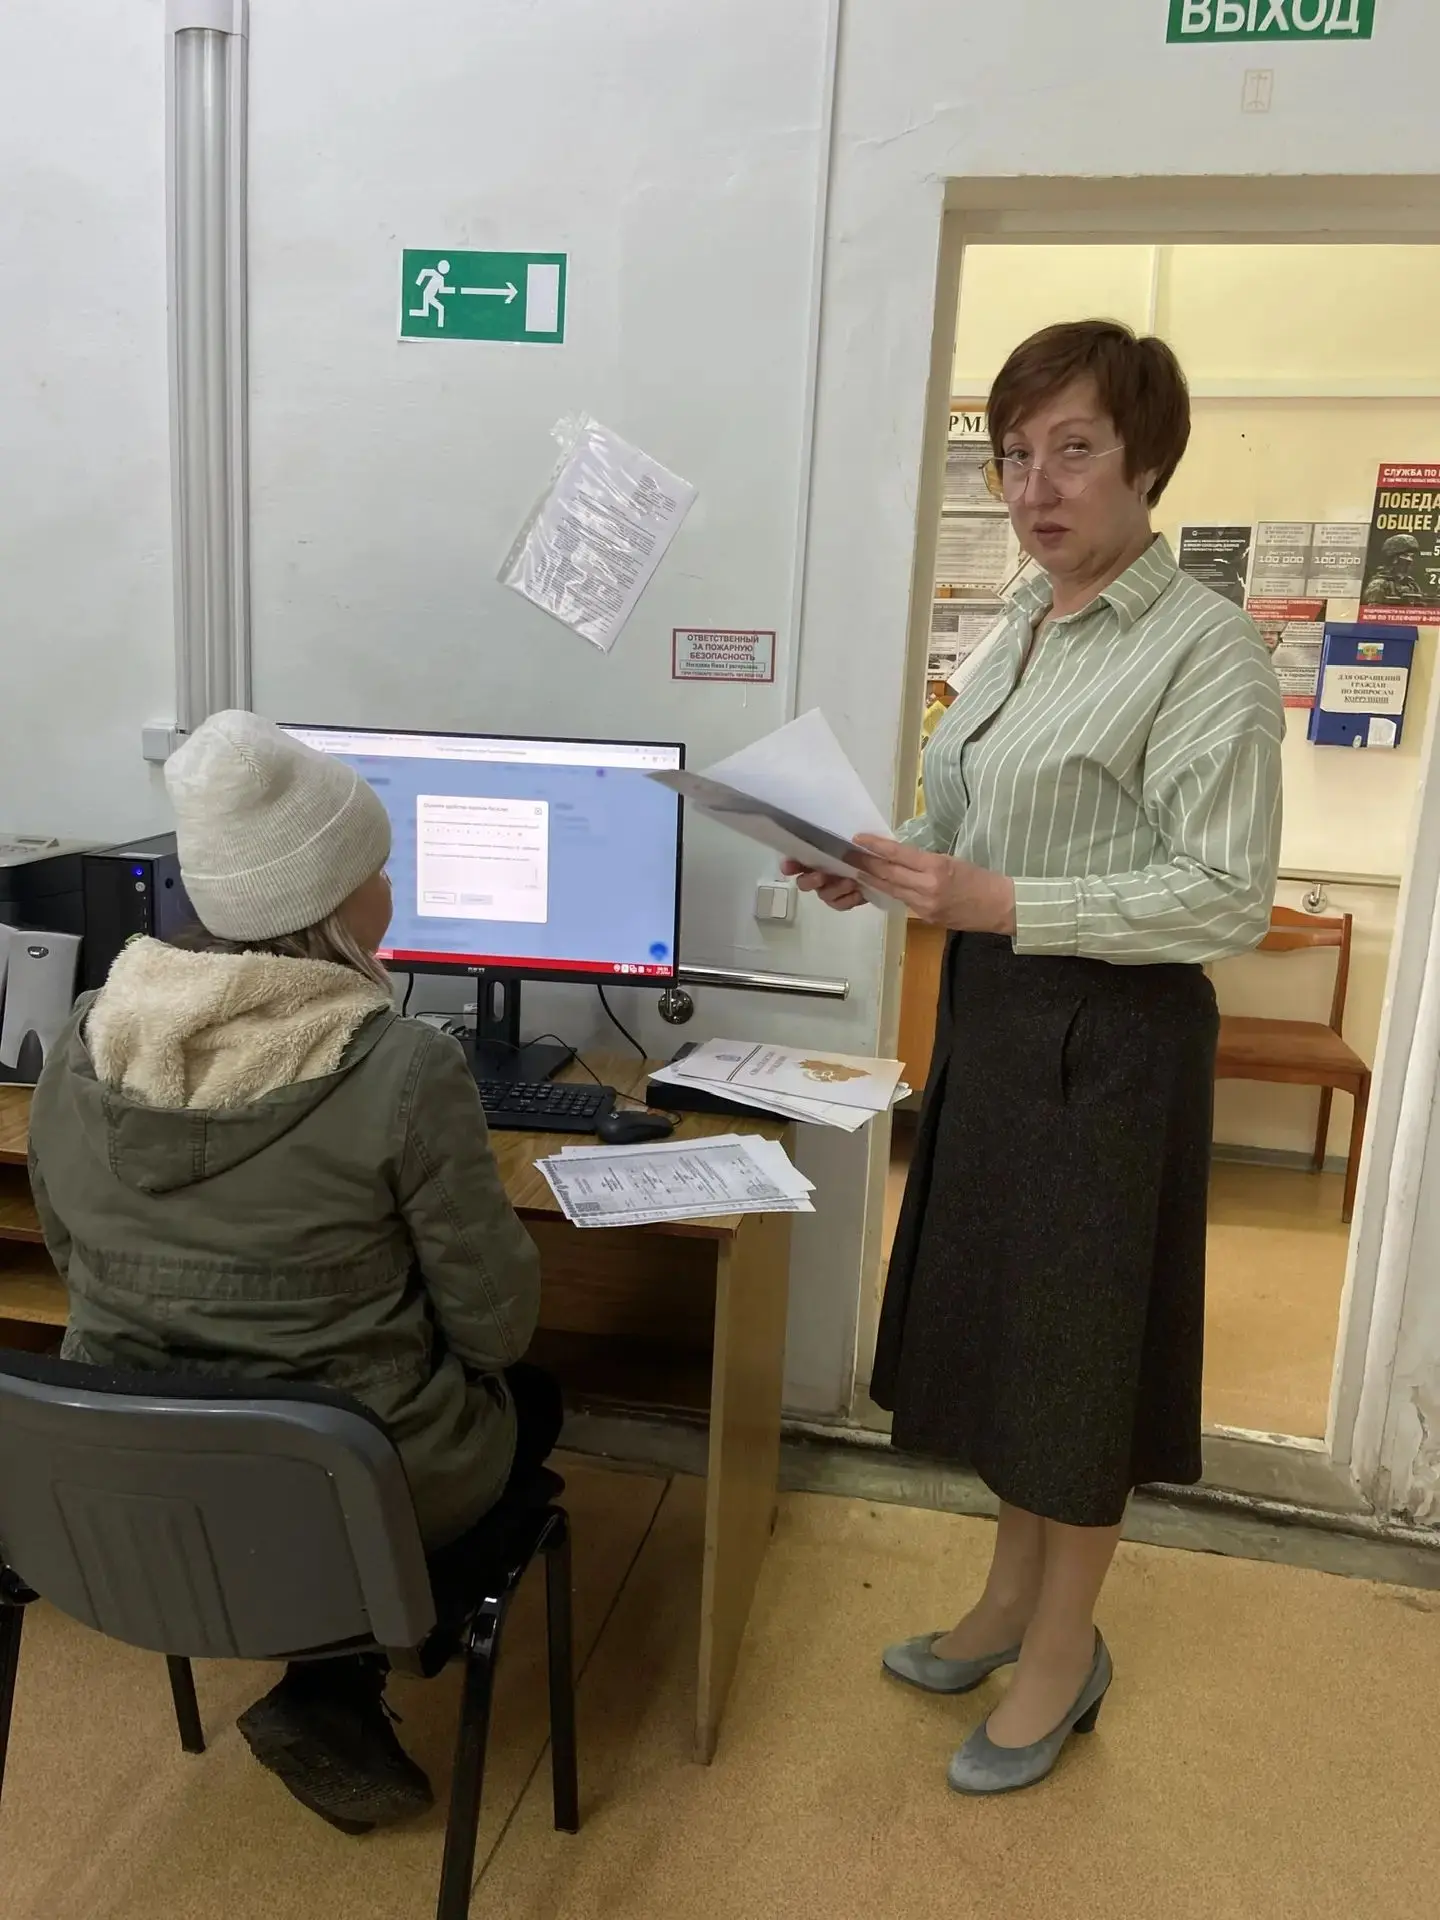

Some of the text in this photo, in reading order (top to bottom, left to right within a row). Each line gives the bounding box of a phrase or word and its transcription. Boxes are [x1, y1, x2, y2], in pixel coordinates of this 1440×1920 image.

[1181, 0, 1360, 34] ВЫХОД
[948, 415, 987, 432] РМ
[1384, 468, 1437, 477] СЛУЖБА ПО
[1376, 514, 1432, 532] ОБЩЕЕ
[687, 634, 759, 643] ОТВЕТСТВЕННЫЙ
[705, 643, 753, 652] ПОЖАРНУЮ
[690, 652, 755, 661] БЕЗОПАСНОСТЬ
